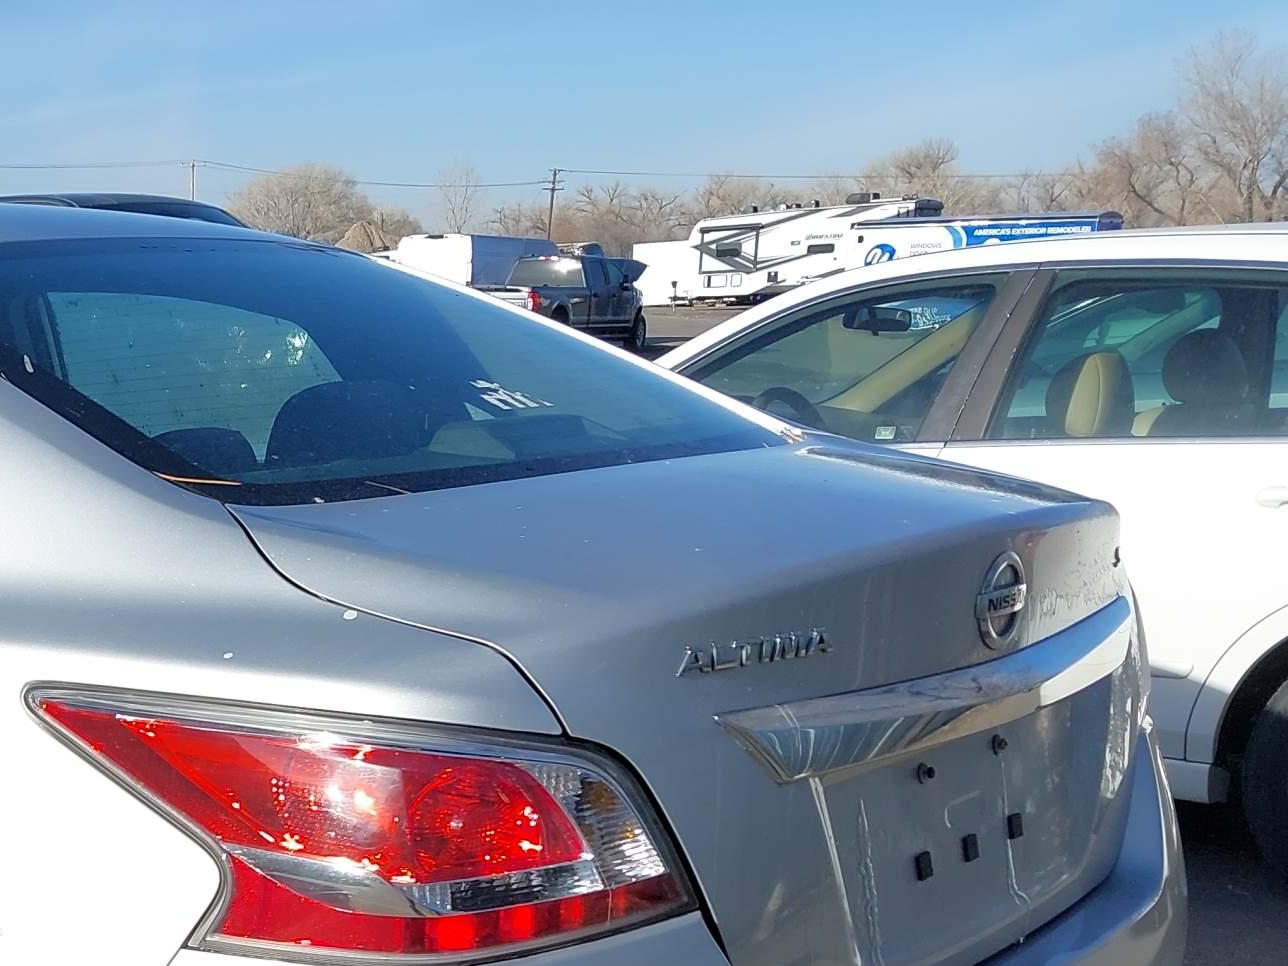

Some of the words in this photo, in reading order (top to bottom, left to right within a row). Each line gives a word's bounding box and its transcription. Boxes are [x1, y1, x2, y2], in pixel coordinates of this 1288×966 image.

[1012, 226, 1046, 235] EXTERIOR
[1047, 225, 1092, 234] REMODELER
[673, 627, 834, 677] ALTIMA
